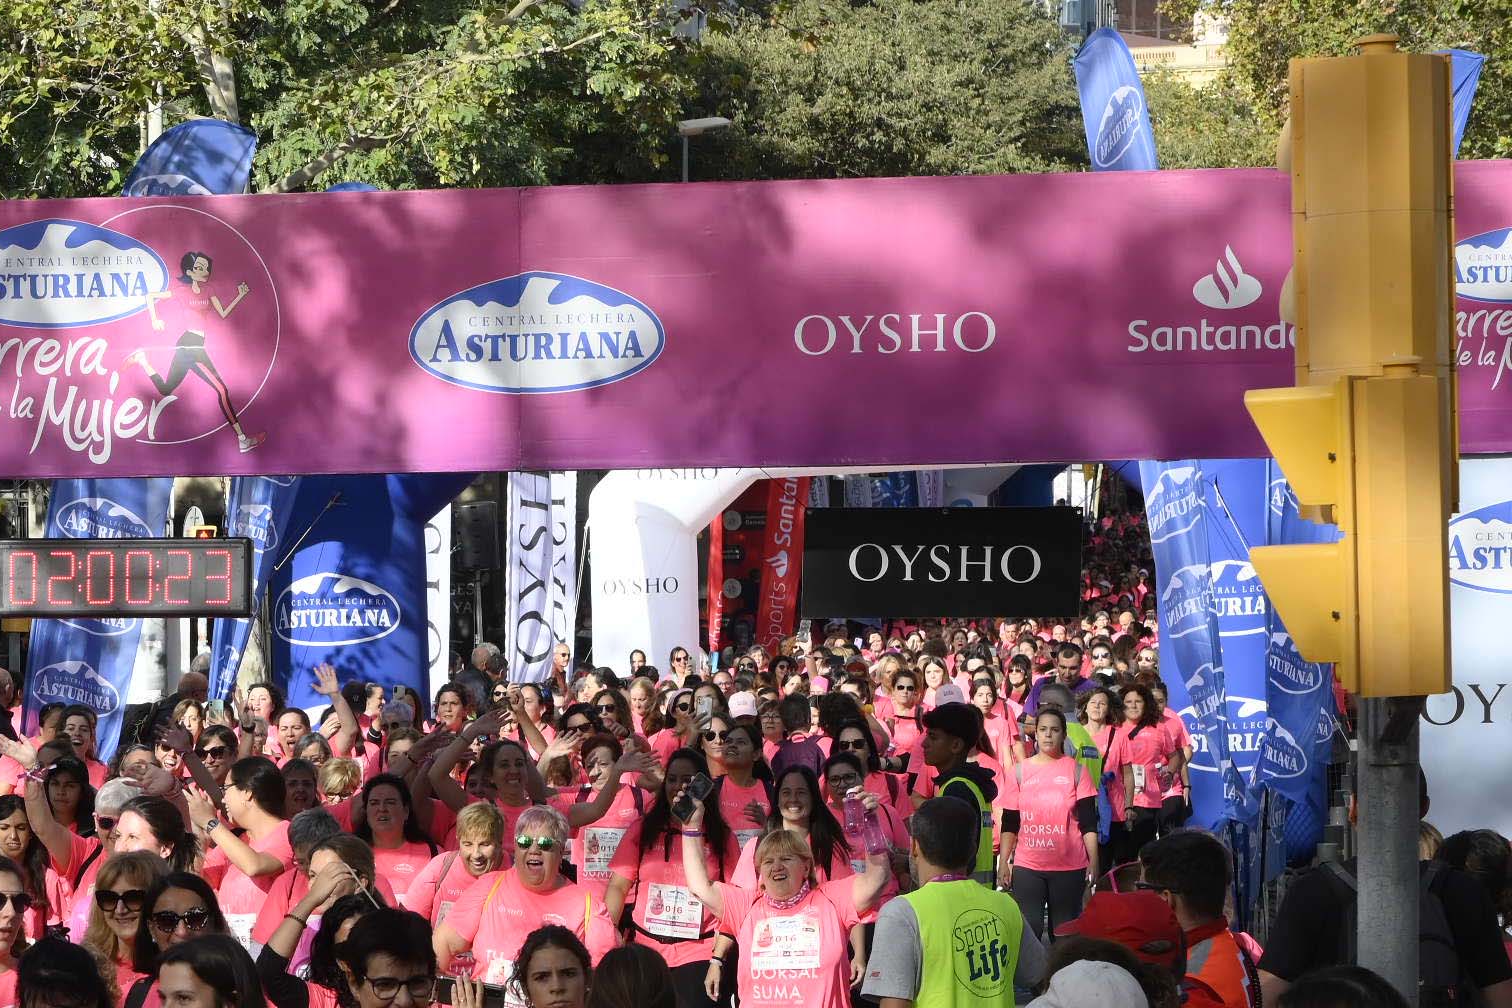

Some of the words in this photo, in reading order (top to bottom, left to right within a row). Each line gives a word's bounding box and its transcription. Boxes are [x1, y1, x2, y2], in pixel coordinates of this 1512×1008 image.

[72, 255, 144, 266] LECHERA
[469, 315, 545, 327] CENTRAL
[555, 312, 636, 325] LECHERA
[794, 311, 996, 355] OYSHO
[1128, 319, 1295, 352] Santand
[429, 319, 645, 363] ASTURIANA
[10, 378, 34, 419] la
[30, 371, 178, 464] Mujer
[9, 551, 232, 604] 02:00:23
[849, 543, 1041, 584] OYSHO
[291, 598, 334, 606] CENTRAL
[338, 598, 386, 606] LECHERA
[603, 577, 679, 595] OYSHO
[280, 604, 391, 629] ASTURIANA
[761, 582, 786, 649] Sports
[37, 674, 111, 711] ASTURIANA
[1419, 684, 1512, 726] OY
[1024, 837, 1054, 848] SUMA
[665, 905, 683, 914] 016
[775, 934, 797, 943] 016
[953, 915, 1000, 952] Sport
[966, 939, 1009, 982] Life
[753, 985, 802, 999] SUMA
